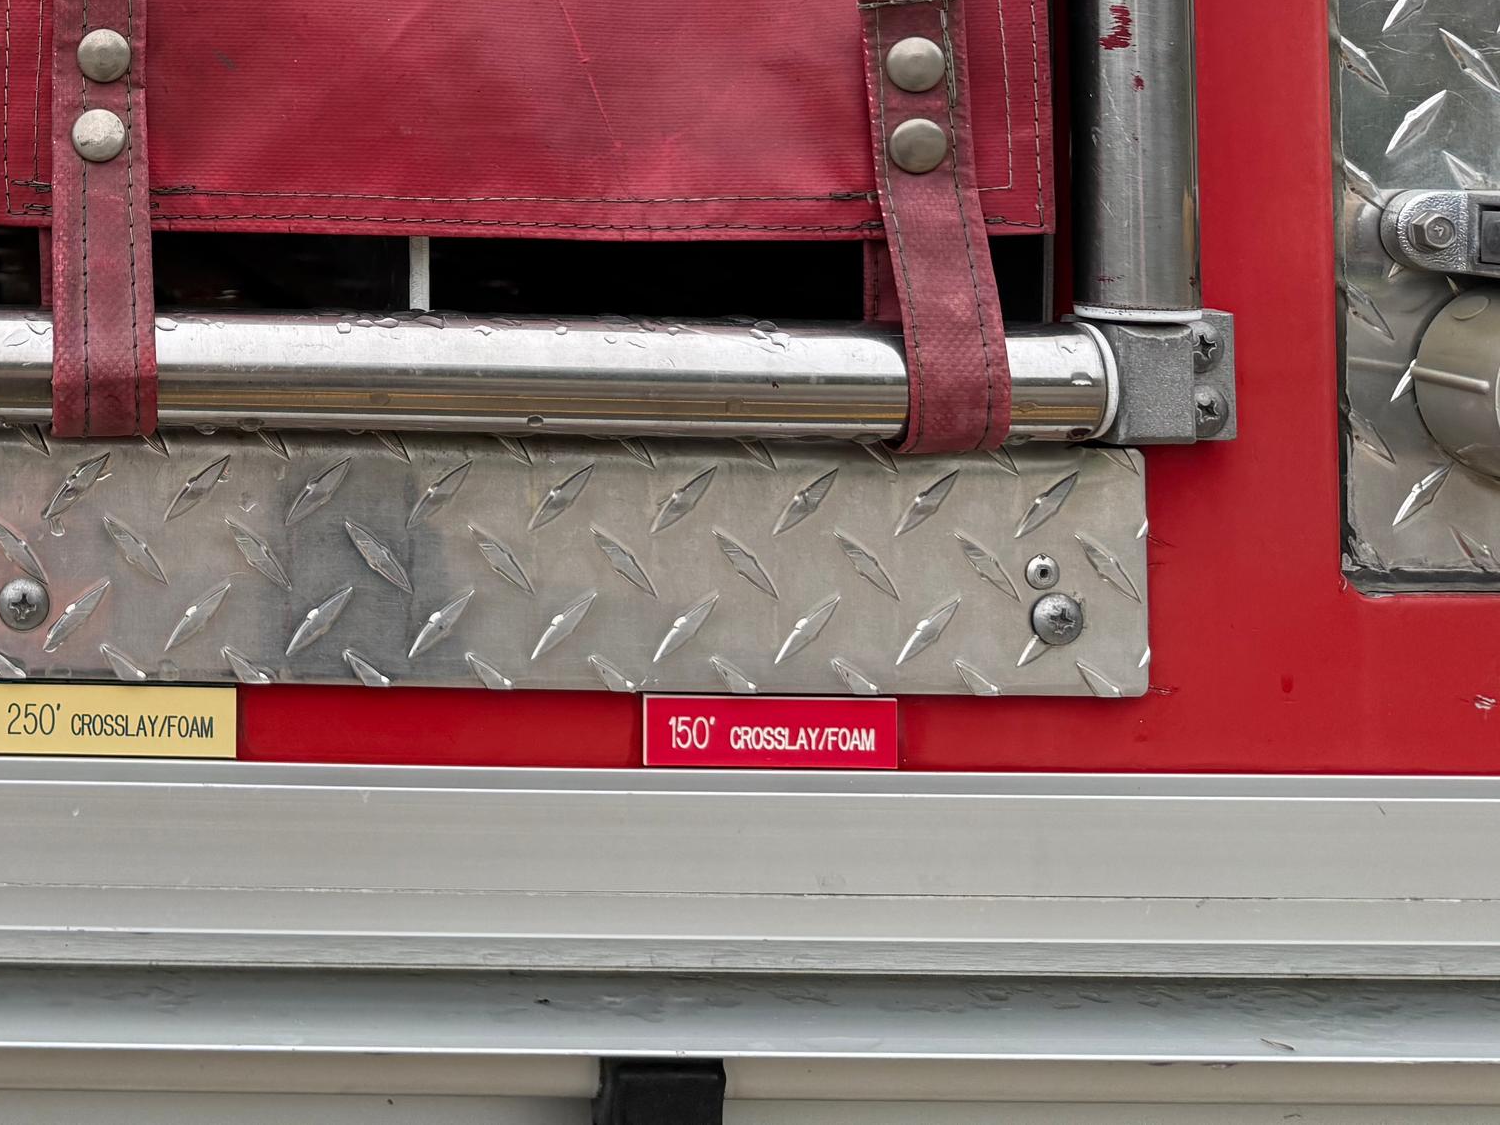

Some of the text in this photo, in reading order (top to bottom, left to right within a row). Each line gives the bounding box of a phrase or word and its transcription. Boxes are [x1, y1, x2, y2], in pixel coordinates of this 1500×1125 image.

[7, 703, 214, 738] 250' CROSSLAY/FOAM
[668, 716, 875, 751] 150' CROSSLAY/FOAM
